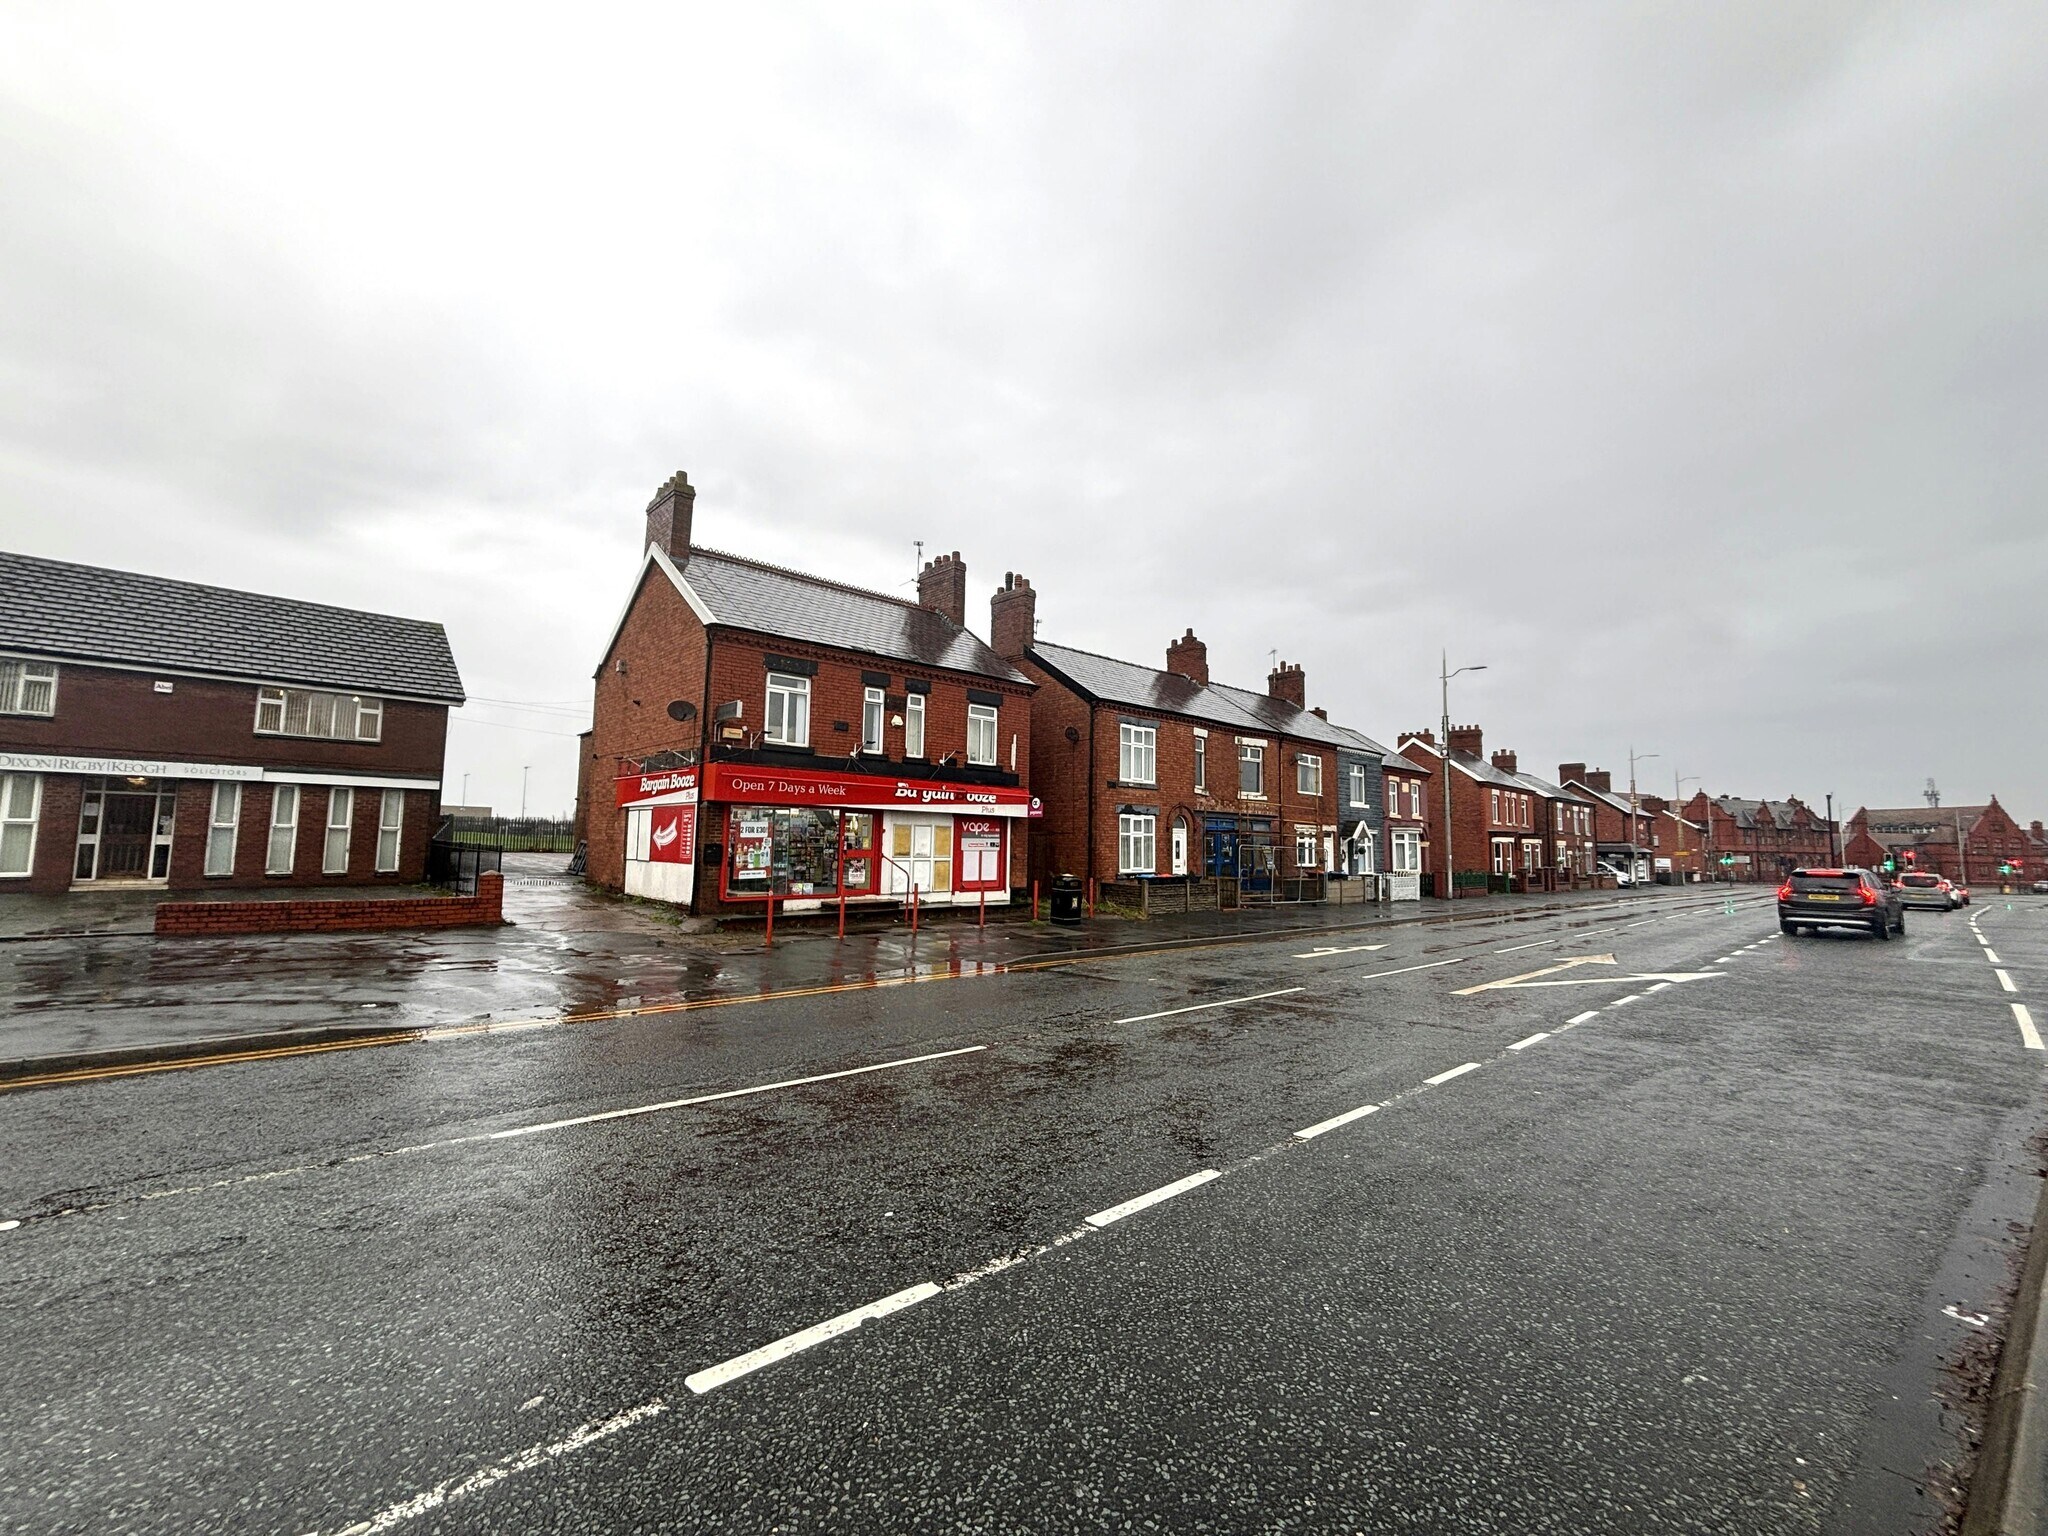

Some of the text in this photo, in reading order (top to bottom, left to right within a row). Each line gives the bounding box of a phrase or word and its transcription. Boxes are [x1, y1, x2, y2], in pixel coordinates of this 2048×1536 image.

[184, 766, 248, 777] SOLICITORS
[640, 773, 695, 795] Bargain Booze
[732, 778, 846, 796] Open 7 Days a Week
[981, 805, 995, 814] Plus
[745, 826, 756, 834] FOR
[962, 821, 990, 836] vape
